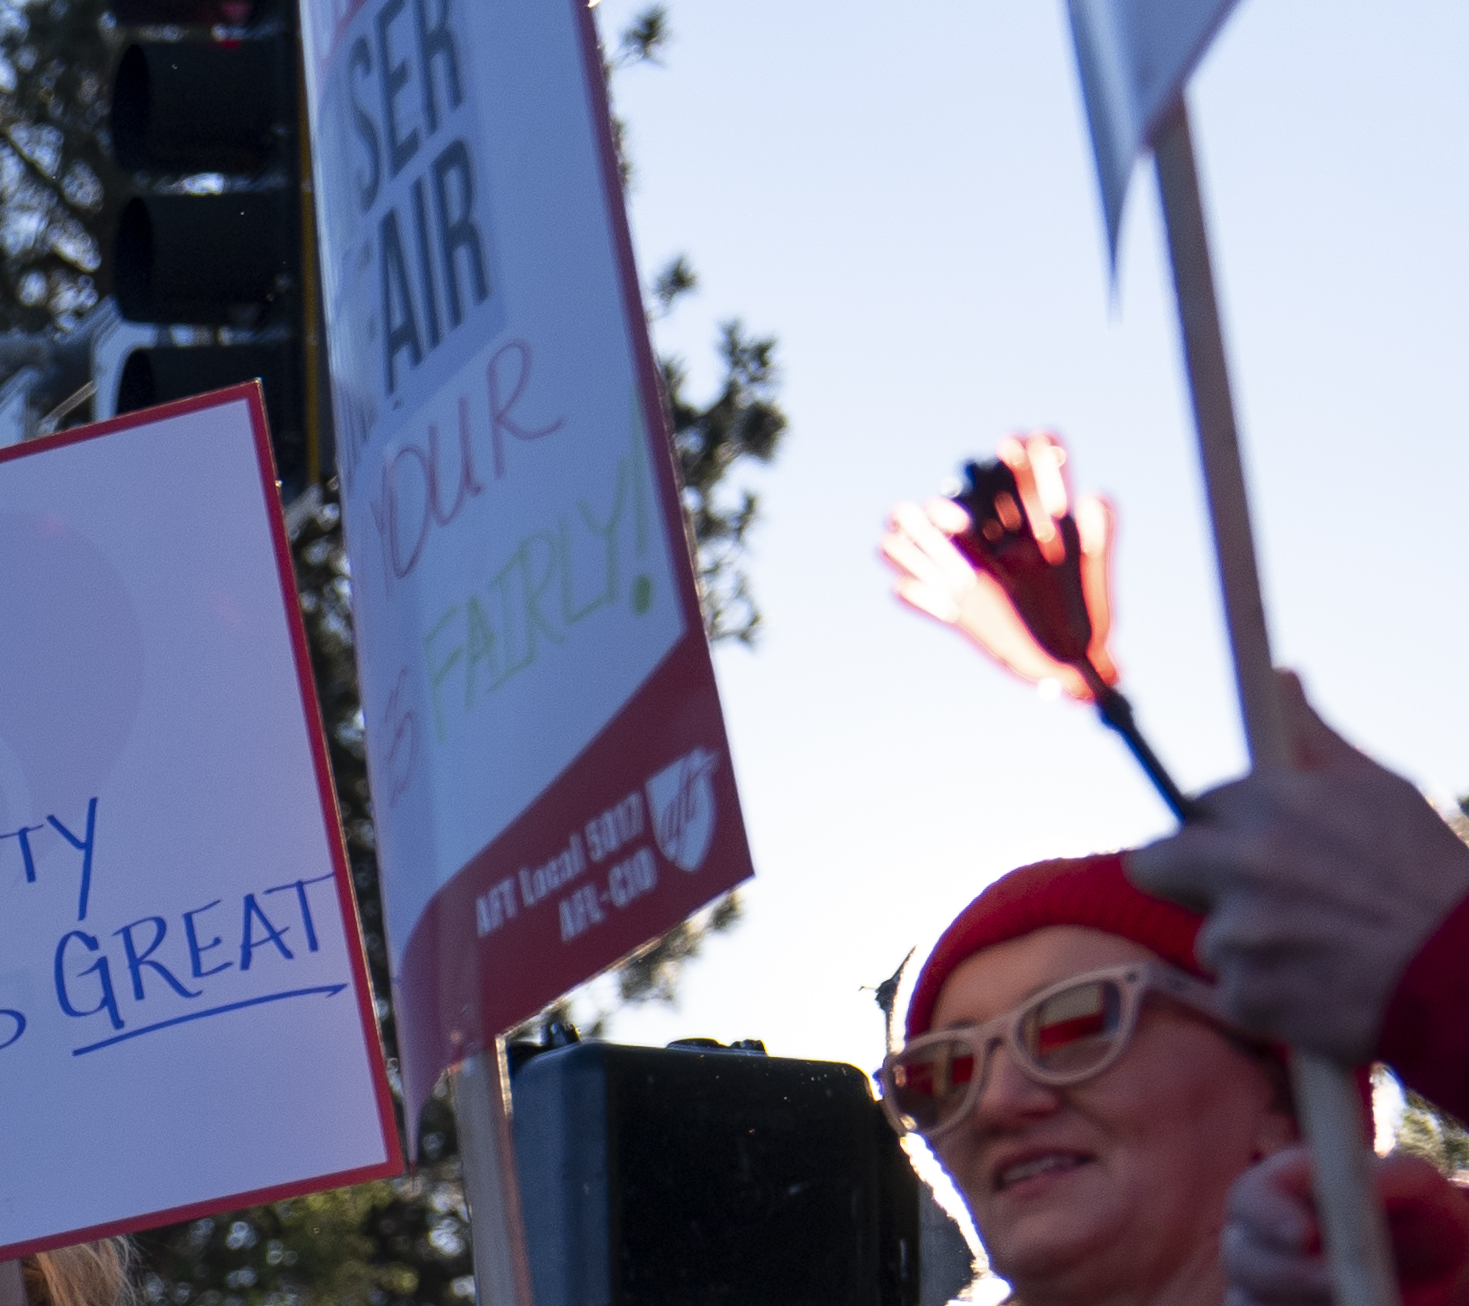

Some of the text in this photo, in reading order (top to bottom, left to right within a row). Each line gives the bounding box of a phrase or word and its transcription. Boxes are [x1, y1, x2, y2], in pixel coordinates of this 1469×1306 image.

[423, 410, 656, 743] FAIRLY!
[518, 831, 588, 908] Local
[55, 875, 336, 1030] GREAT
